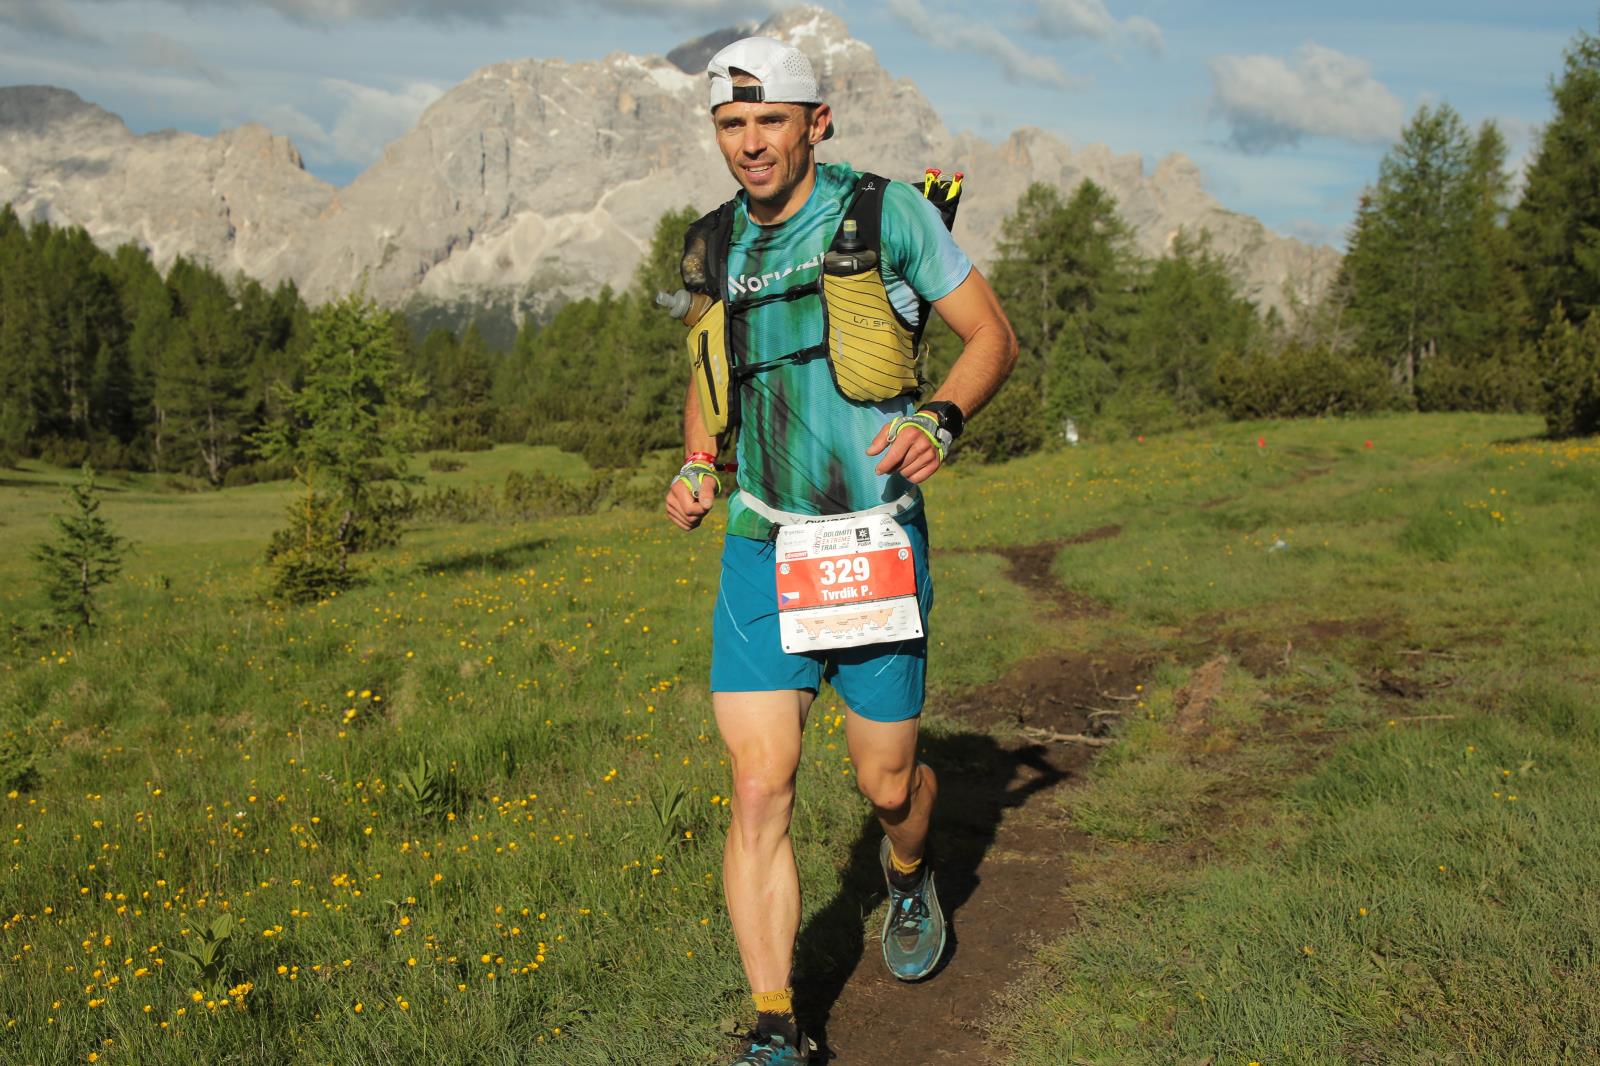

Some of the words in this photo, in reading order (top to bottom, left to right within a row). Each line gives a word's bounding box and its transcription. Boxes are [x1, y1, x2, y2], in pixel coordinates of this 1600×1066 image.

[823, 528, 853, 538] DOLOMITI
[821, 543, 837, 551] TRAIL
[820, 556, 871, 586] 329
[861, 585, 873, 597] P.
